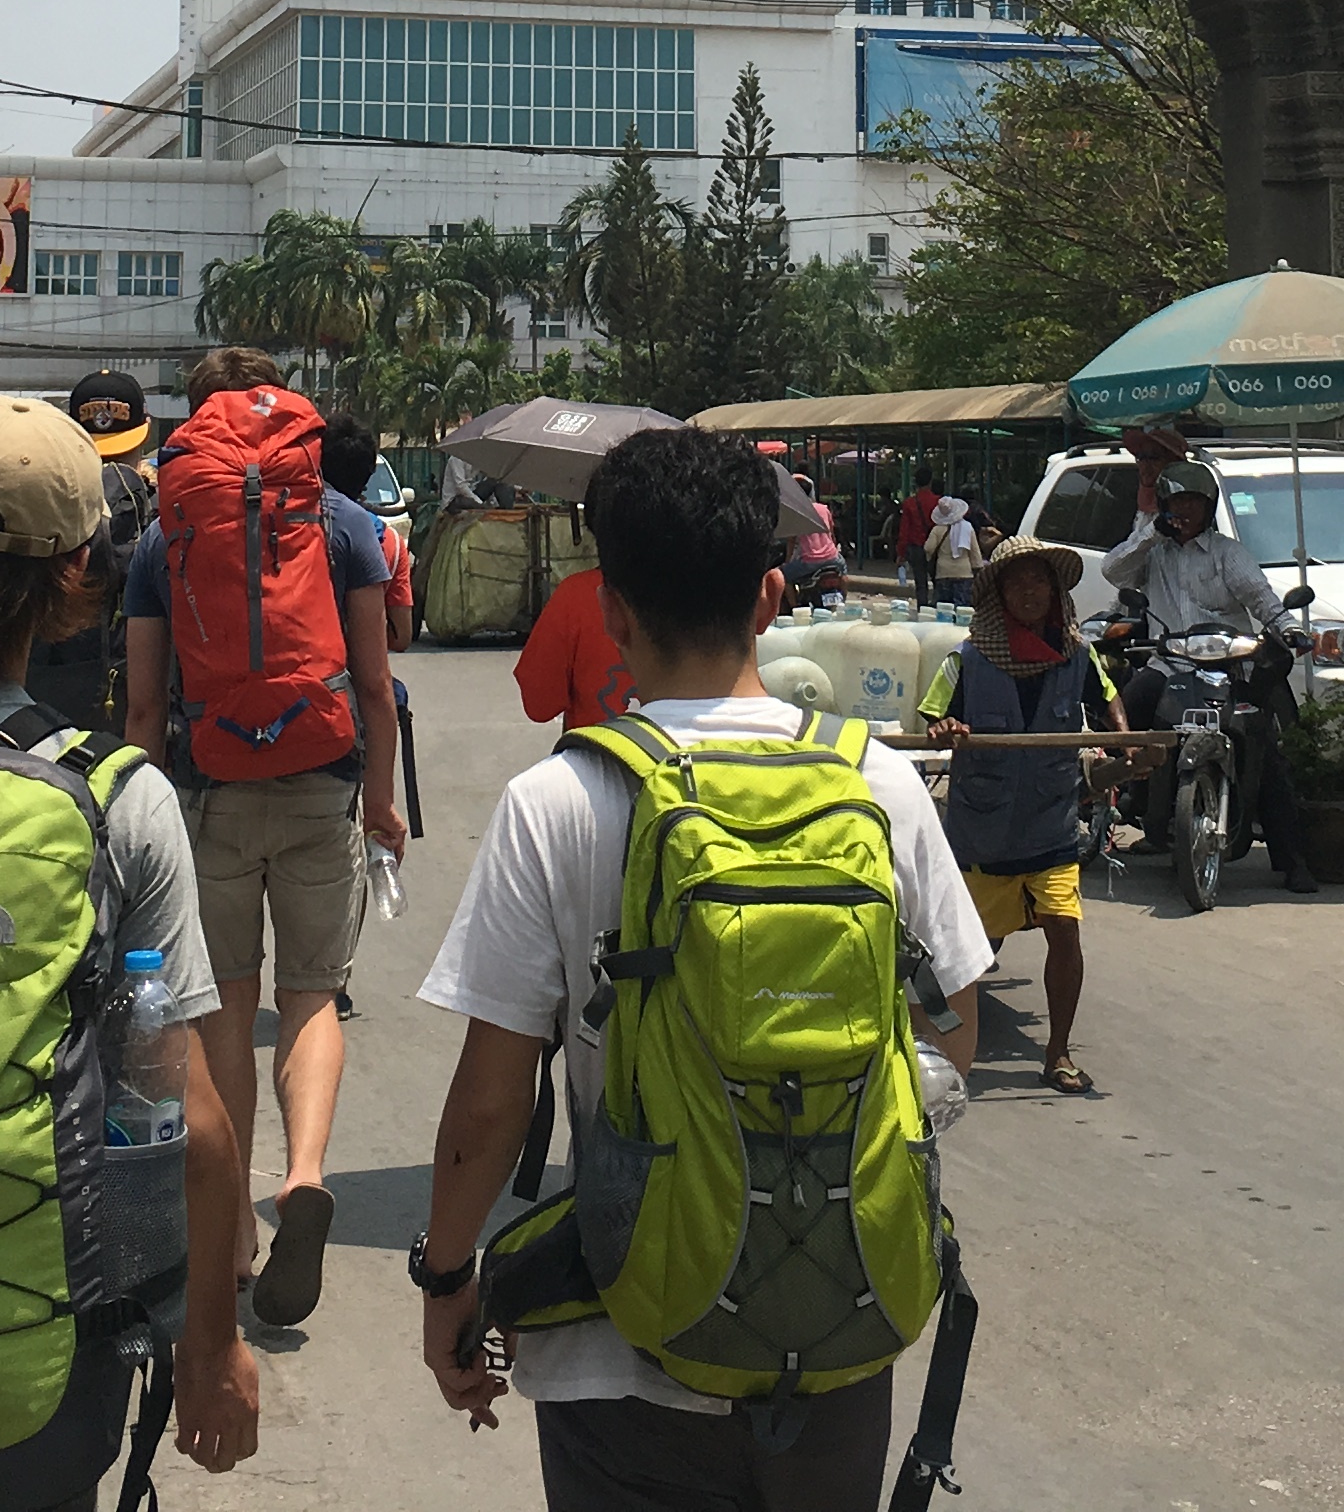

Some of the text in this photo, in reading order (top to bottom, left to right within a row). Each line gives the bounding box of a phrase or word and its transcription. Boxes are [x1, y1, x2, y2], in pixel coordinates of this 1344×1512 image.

[1081, 381, 1201, 405] 090 068 067
[1228, 378, 1264, 393] 066
[1294, 374, 1332, 390] 060
